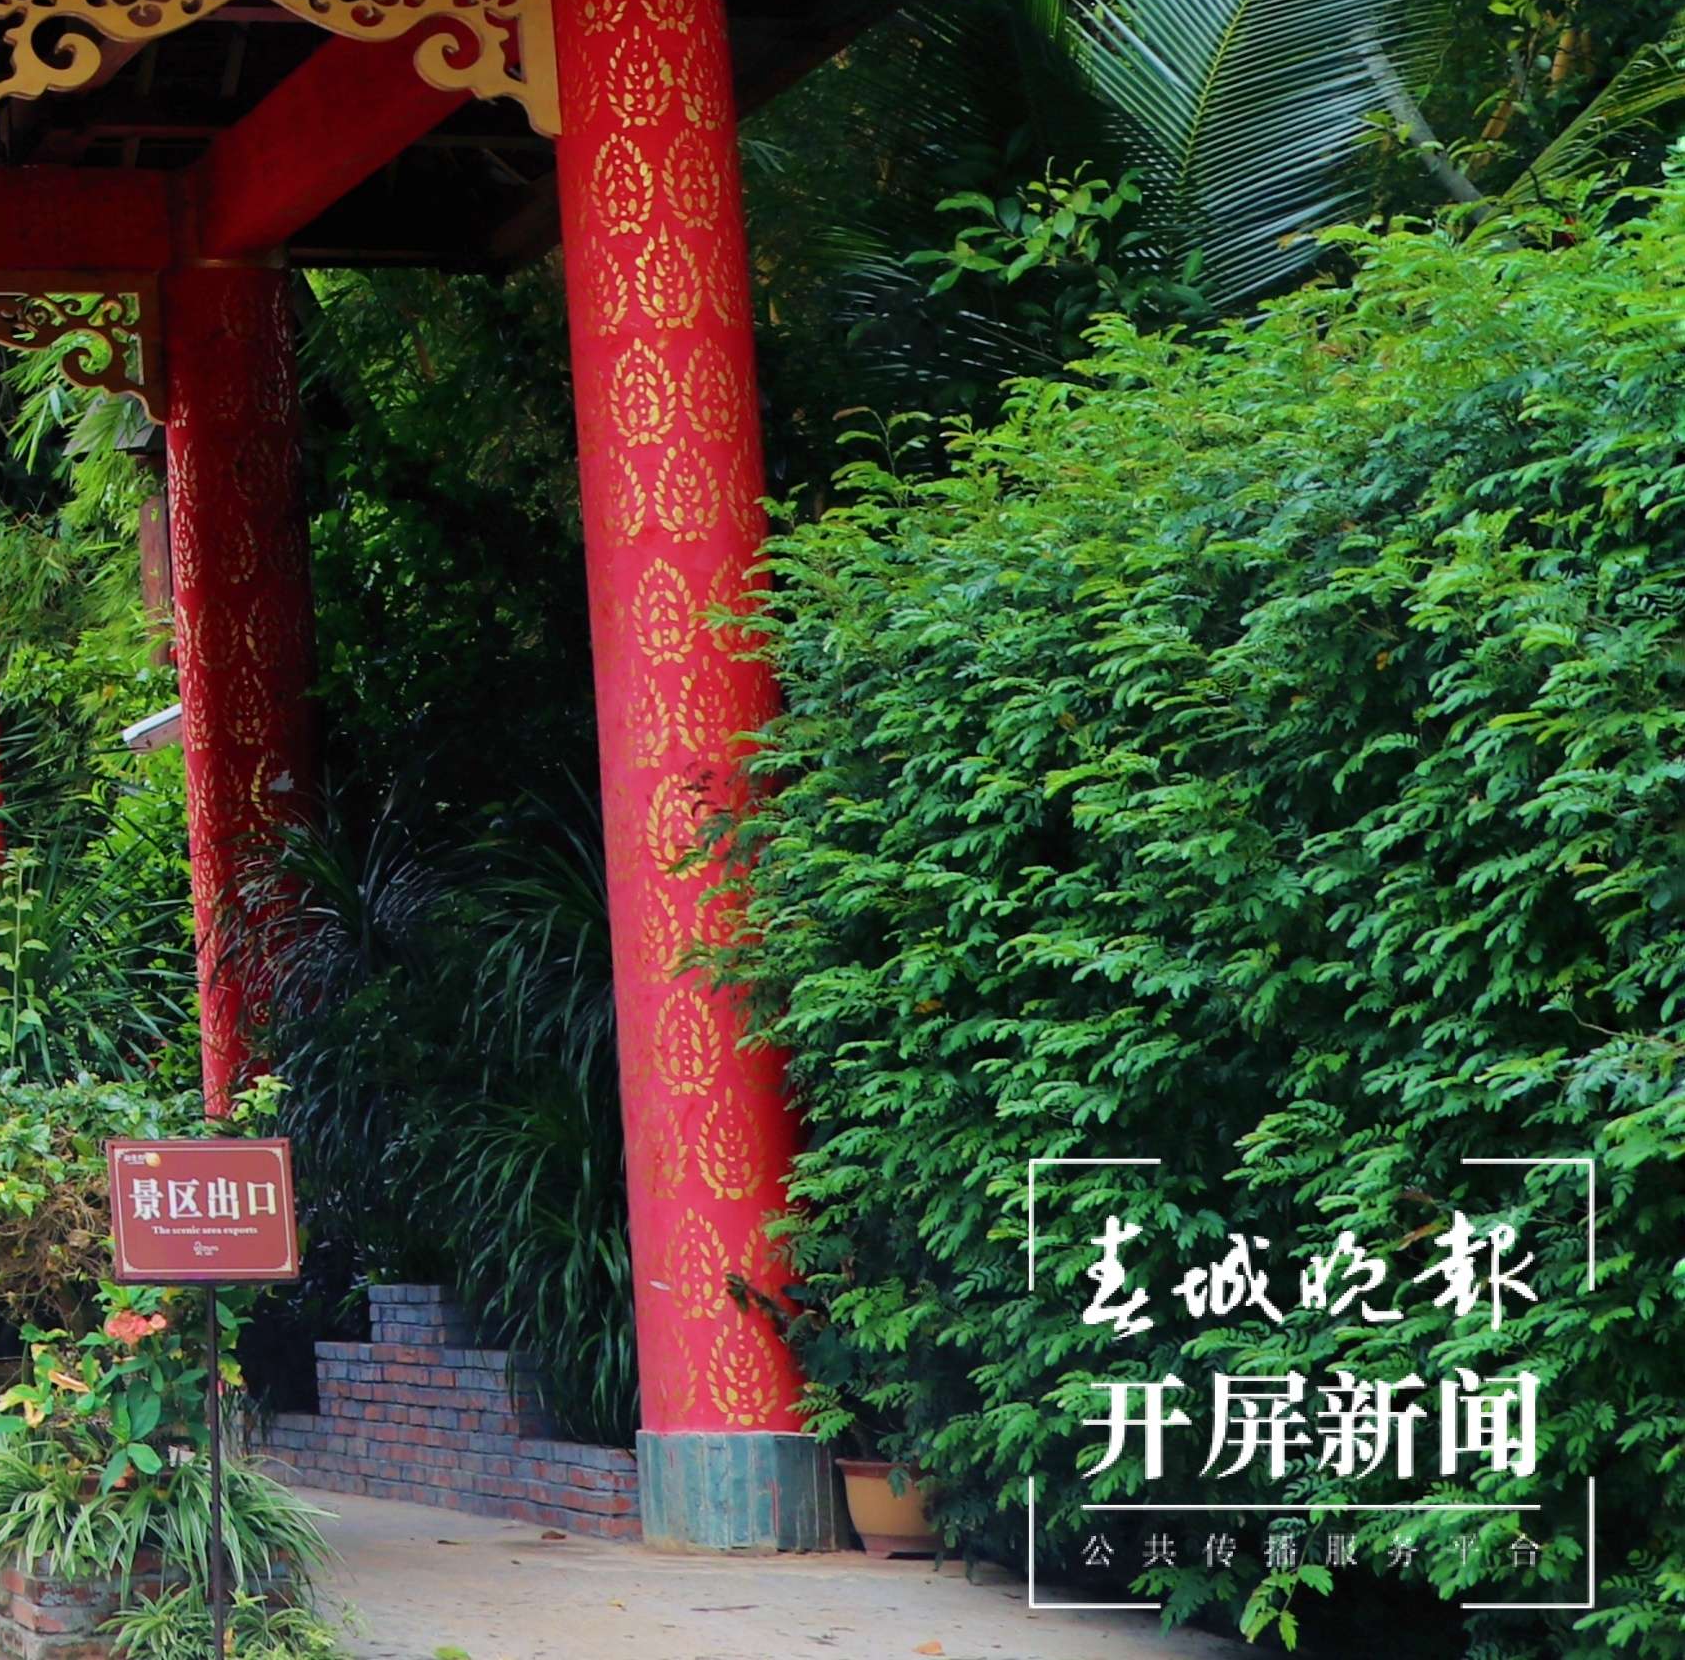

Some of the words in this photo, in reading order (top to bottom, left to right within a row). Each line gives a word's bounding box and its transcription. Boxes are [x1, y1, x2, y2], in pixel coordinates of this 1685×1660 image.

[128, 1177, 277, 1220] 景区出口
[151, 1225, 171, 1235] The
[171, 1224, 201, 1236] scenic
[202, 1226, 222, 1235] area
[223, 1226, 259, 1237] exports
